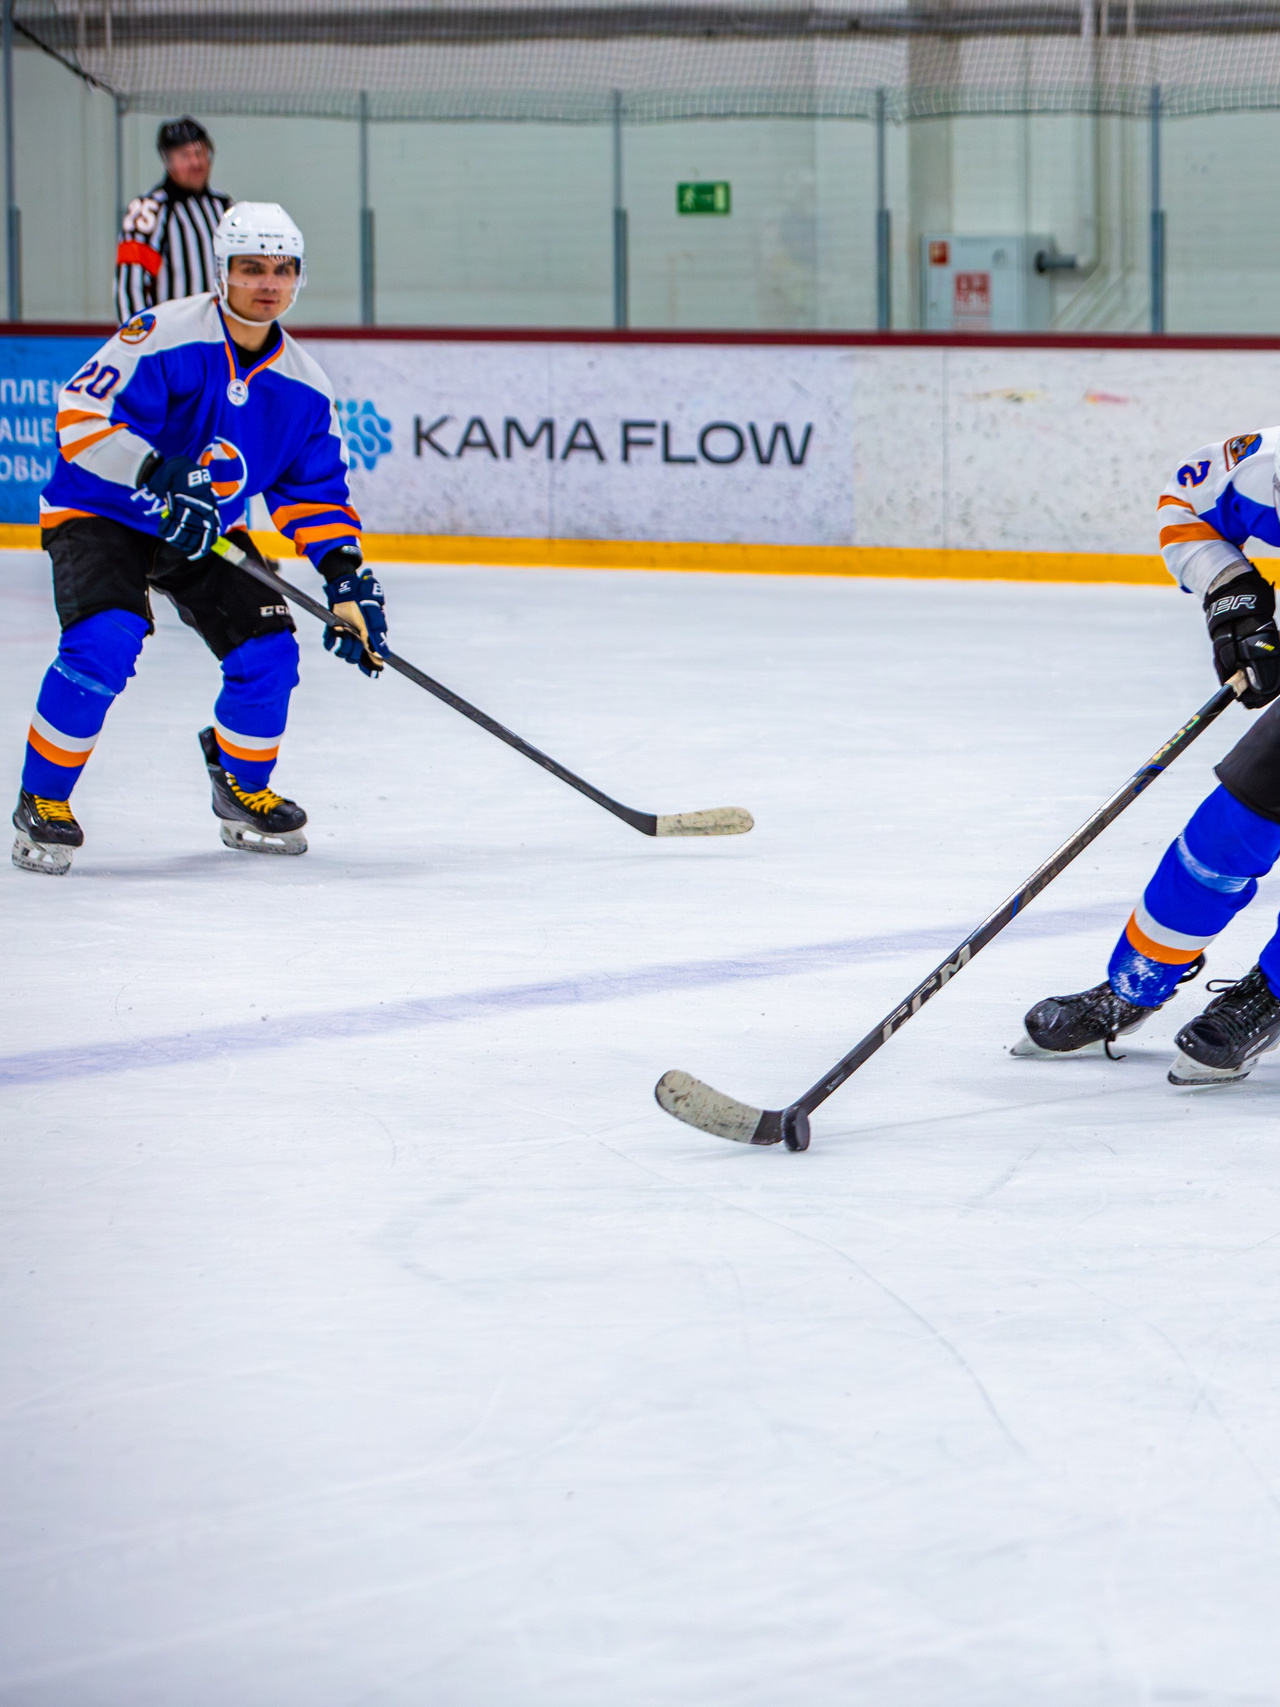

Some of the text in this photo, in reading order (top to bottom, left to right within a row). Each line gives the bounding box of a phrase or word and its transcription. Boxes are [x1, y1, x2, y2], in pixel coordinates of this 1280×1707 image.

[65, 359, 121, 402] 20
[413, 414, 813, 466] KAMA FLOW
[1177, 459, 1212, 488] 2
[882, 944, 971, 1043] CCM
